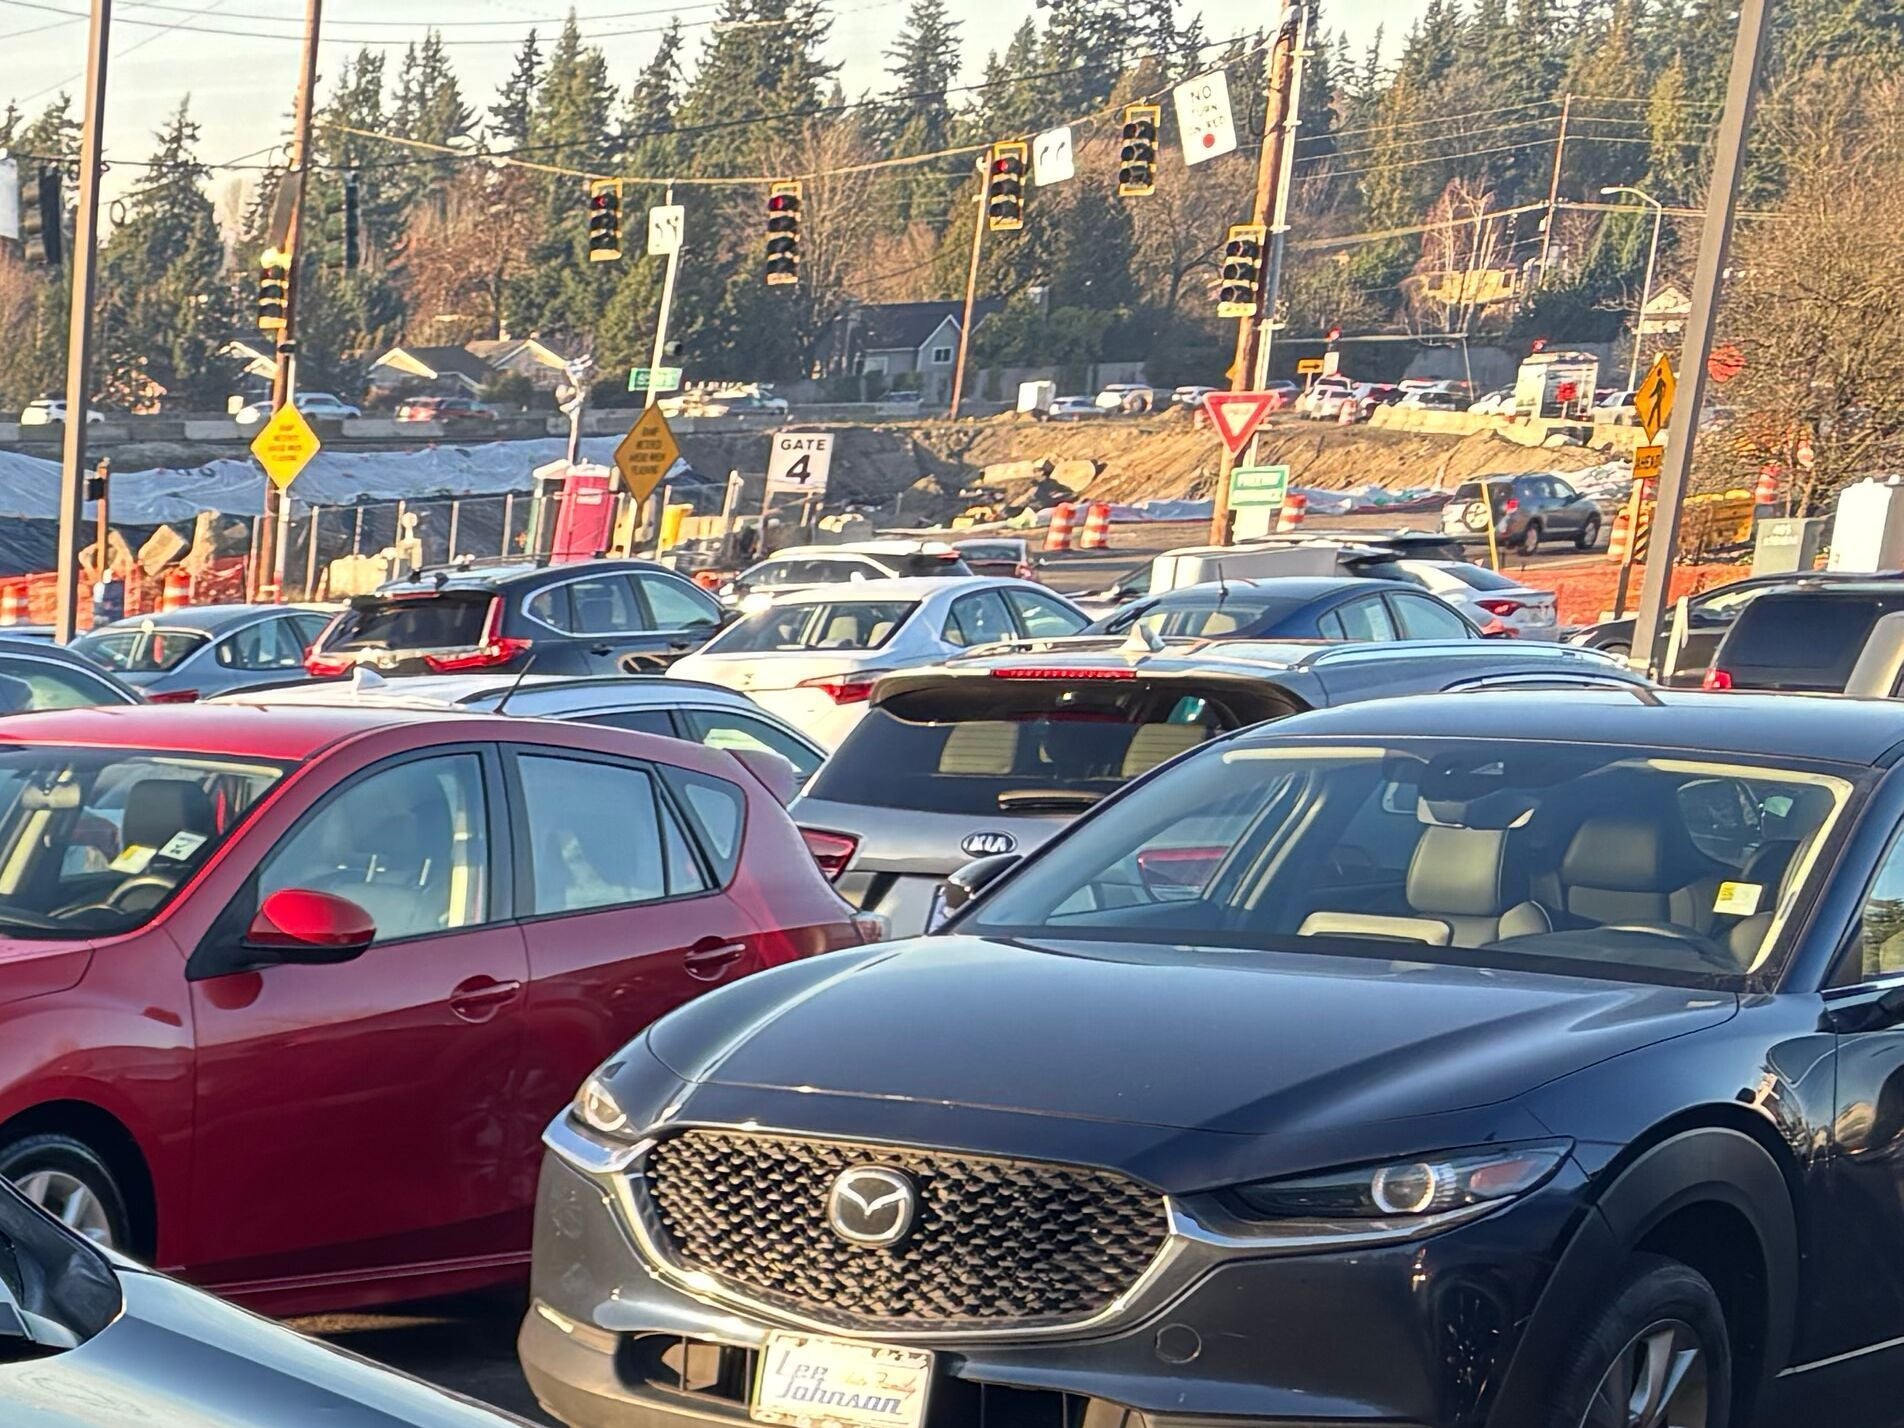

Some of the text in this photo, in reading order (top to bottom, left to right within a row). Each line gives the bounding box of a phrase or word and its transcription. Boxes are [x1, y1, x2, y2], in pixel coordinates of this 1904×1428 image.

[780, 439, 827, 451] GATE
[785, 454, 811, 484] 4
[968, 835, 1007, 852] KIA
[776, 1350, 829, 1382] Lee
[776, 1372, 903, 1416] Johnson
